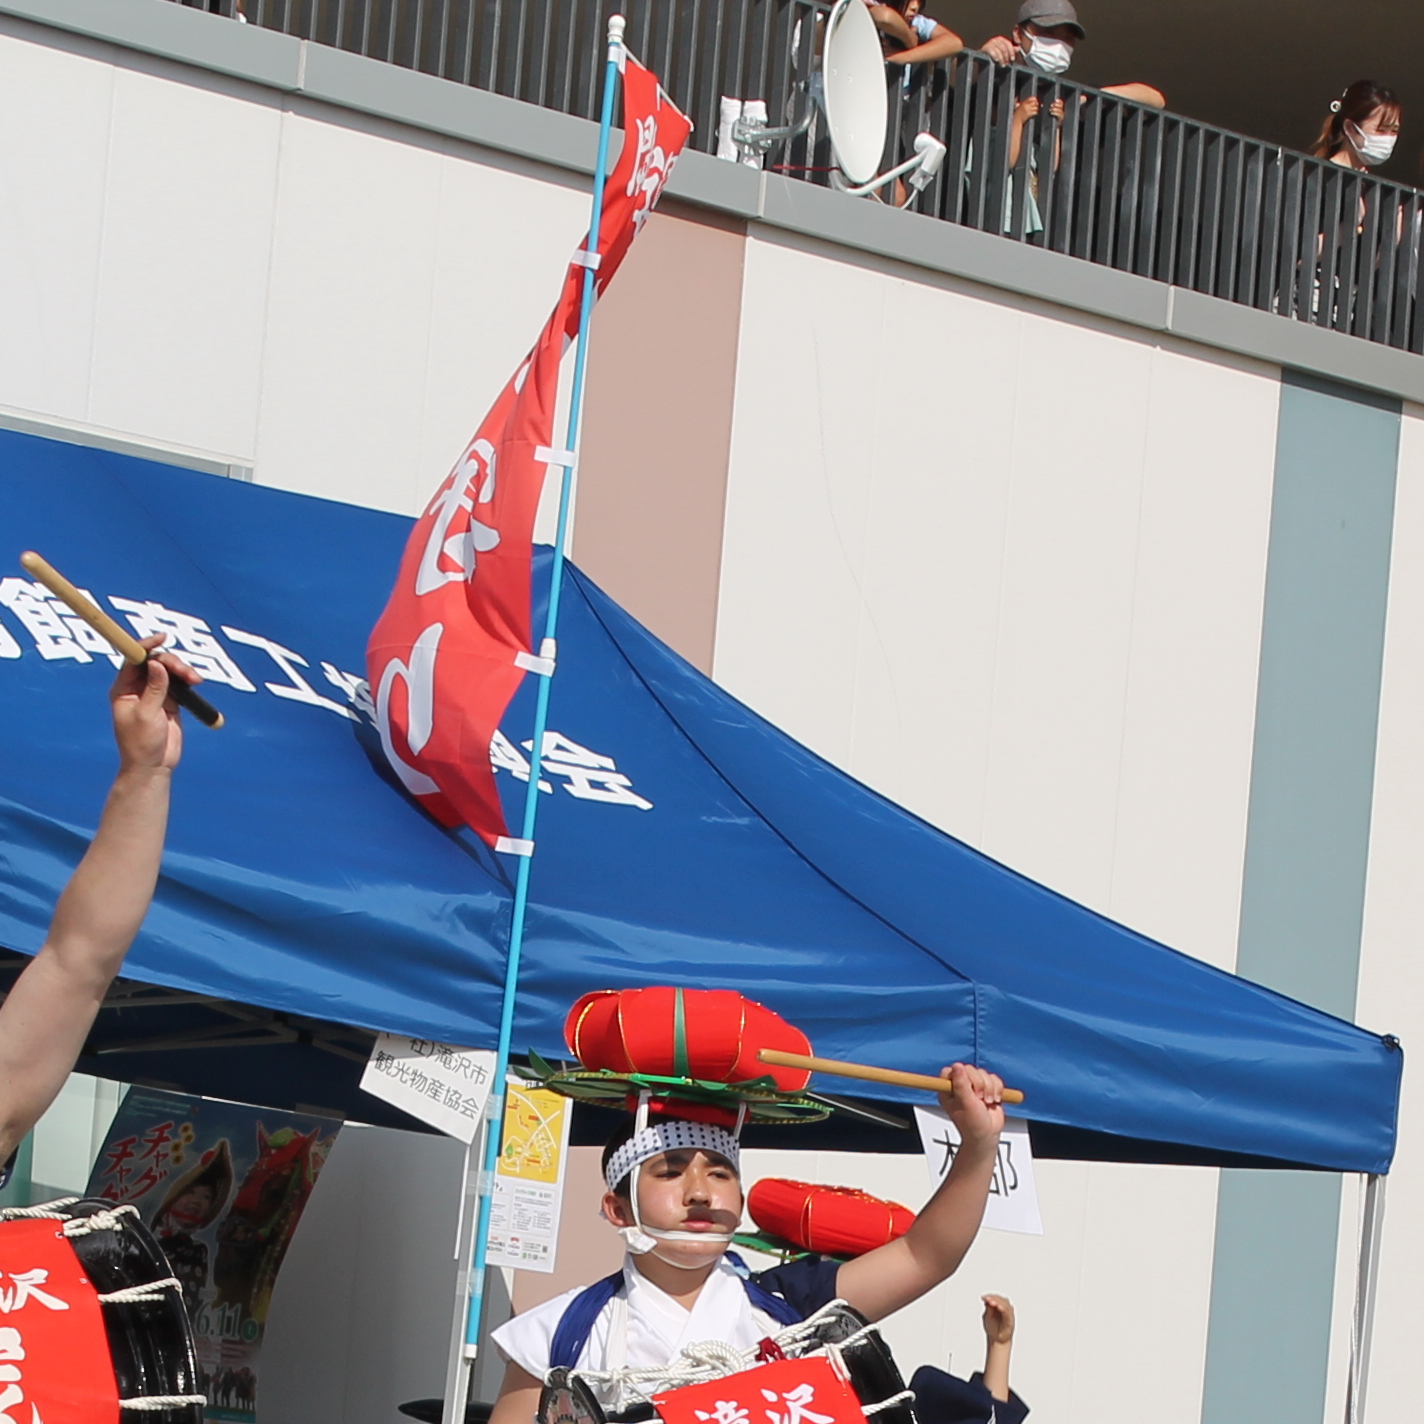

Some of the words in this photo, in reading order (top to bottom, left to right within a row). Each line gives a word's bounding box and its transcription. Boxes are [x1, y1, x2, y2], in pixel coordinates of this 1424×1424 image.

[374, 1049, 480, 1120] 観光物産協会
